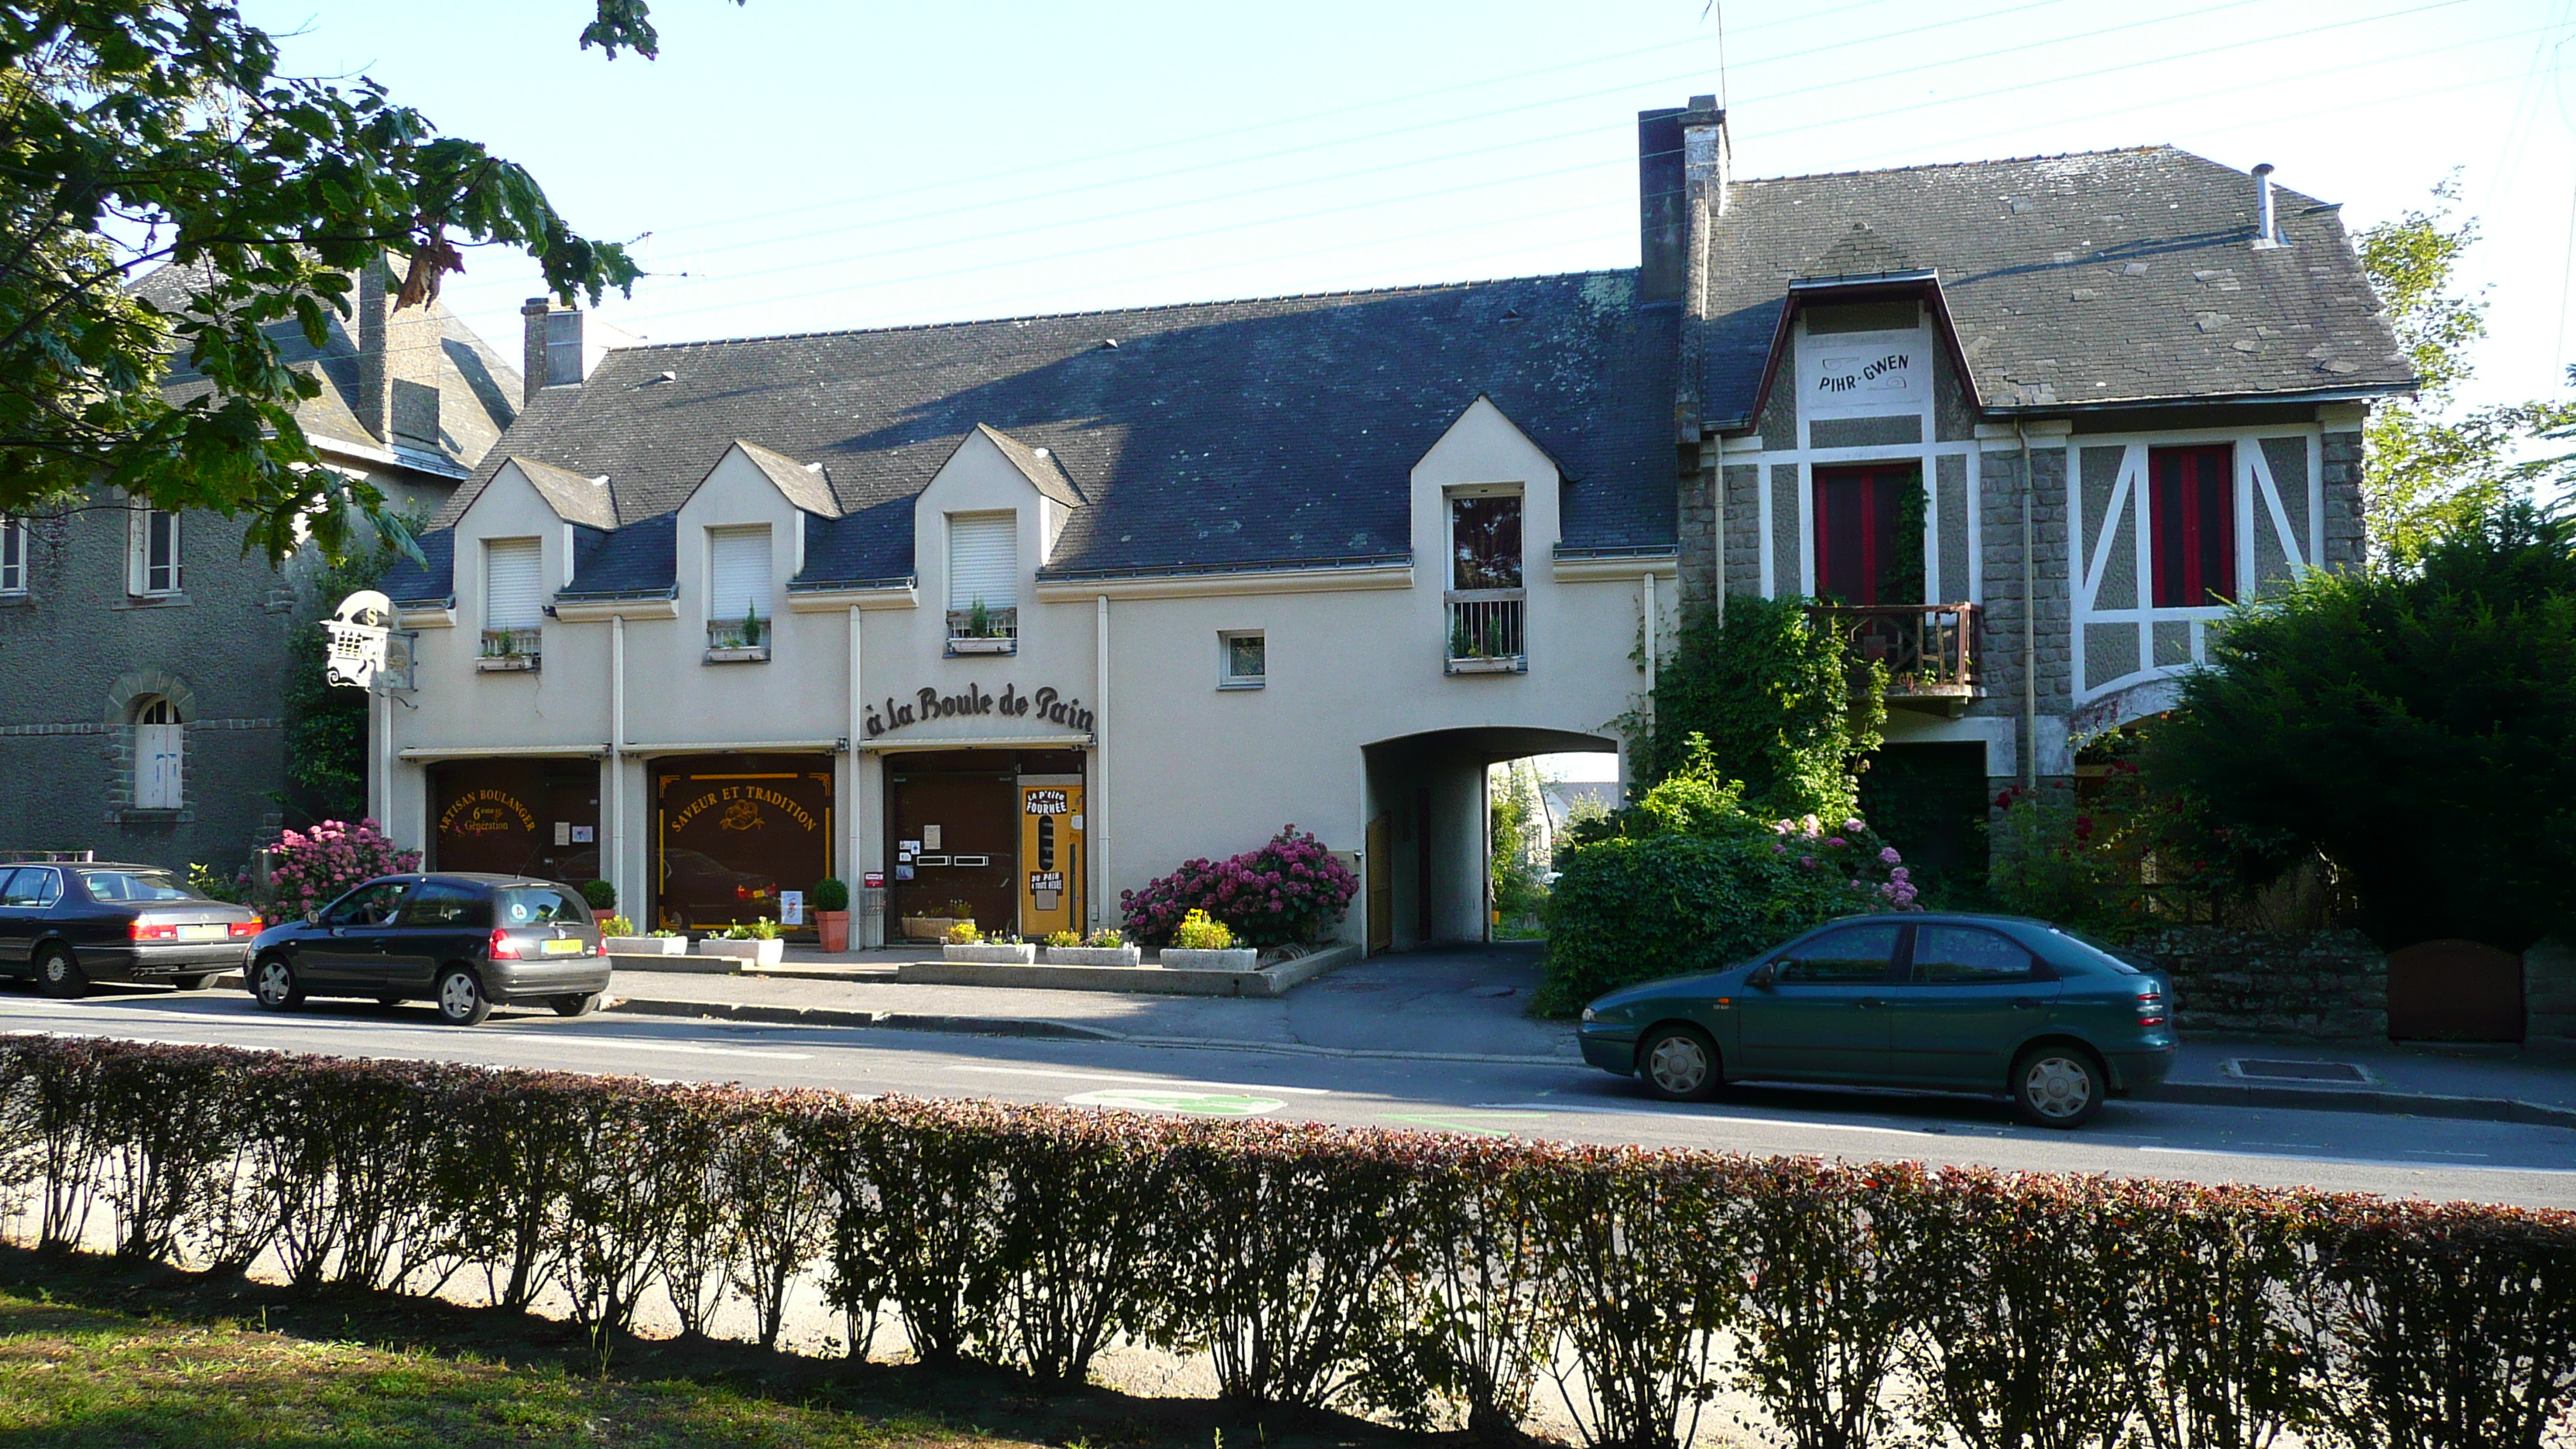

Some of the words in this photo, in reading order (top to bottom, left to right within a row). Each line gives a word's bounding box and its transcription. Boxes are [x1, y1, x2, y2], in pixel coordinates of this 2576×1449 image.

[1819, 355, 1909, 392] PIHR-GWEN
[865, 704, 886, 735] à
[886, 697, 916, 730] la
[916, 682, 994, 721] Boule
[999, 683, 1029, 717] de
[1035, 686, 1094, 731] Pain
[1027, 792, 1036, 801] LA
[439, 791, 476, 833] ARTISAN
[480, 789, 536, 832] BOULANGER
[672, 793, 718, 832] SAVEUR
[722, 786, 739, 800] ET
[746, 786, 817, 832] TRADITION
[1026, 800, 1067, 816] FOURNÉE
[464, 820, 509, 831] Génération
[1043, 872, 1060, 882] PAIN
[516, 906, 524, 916] A
